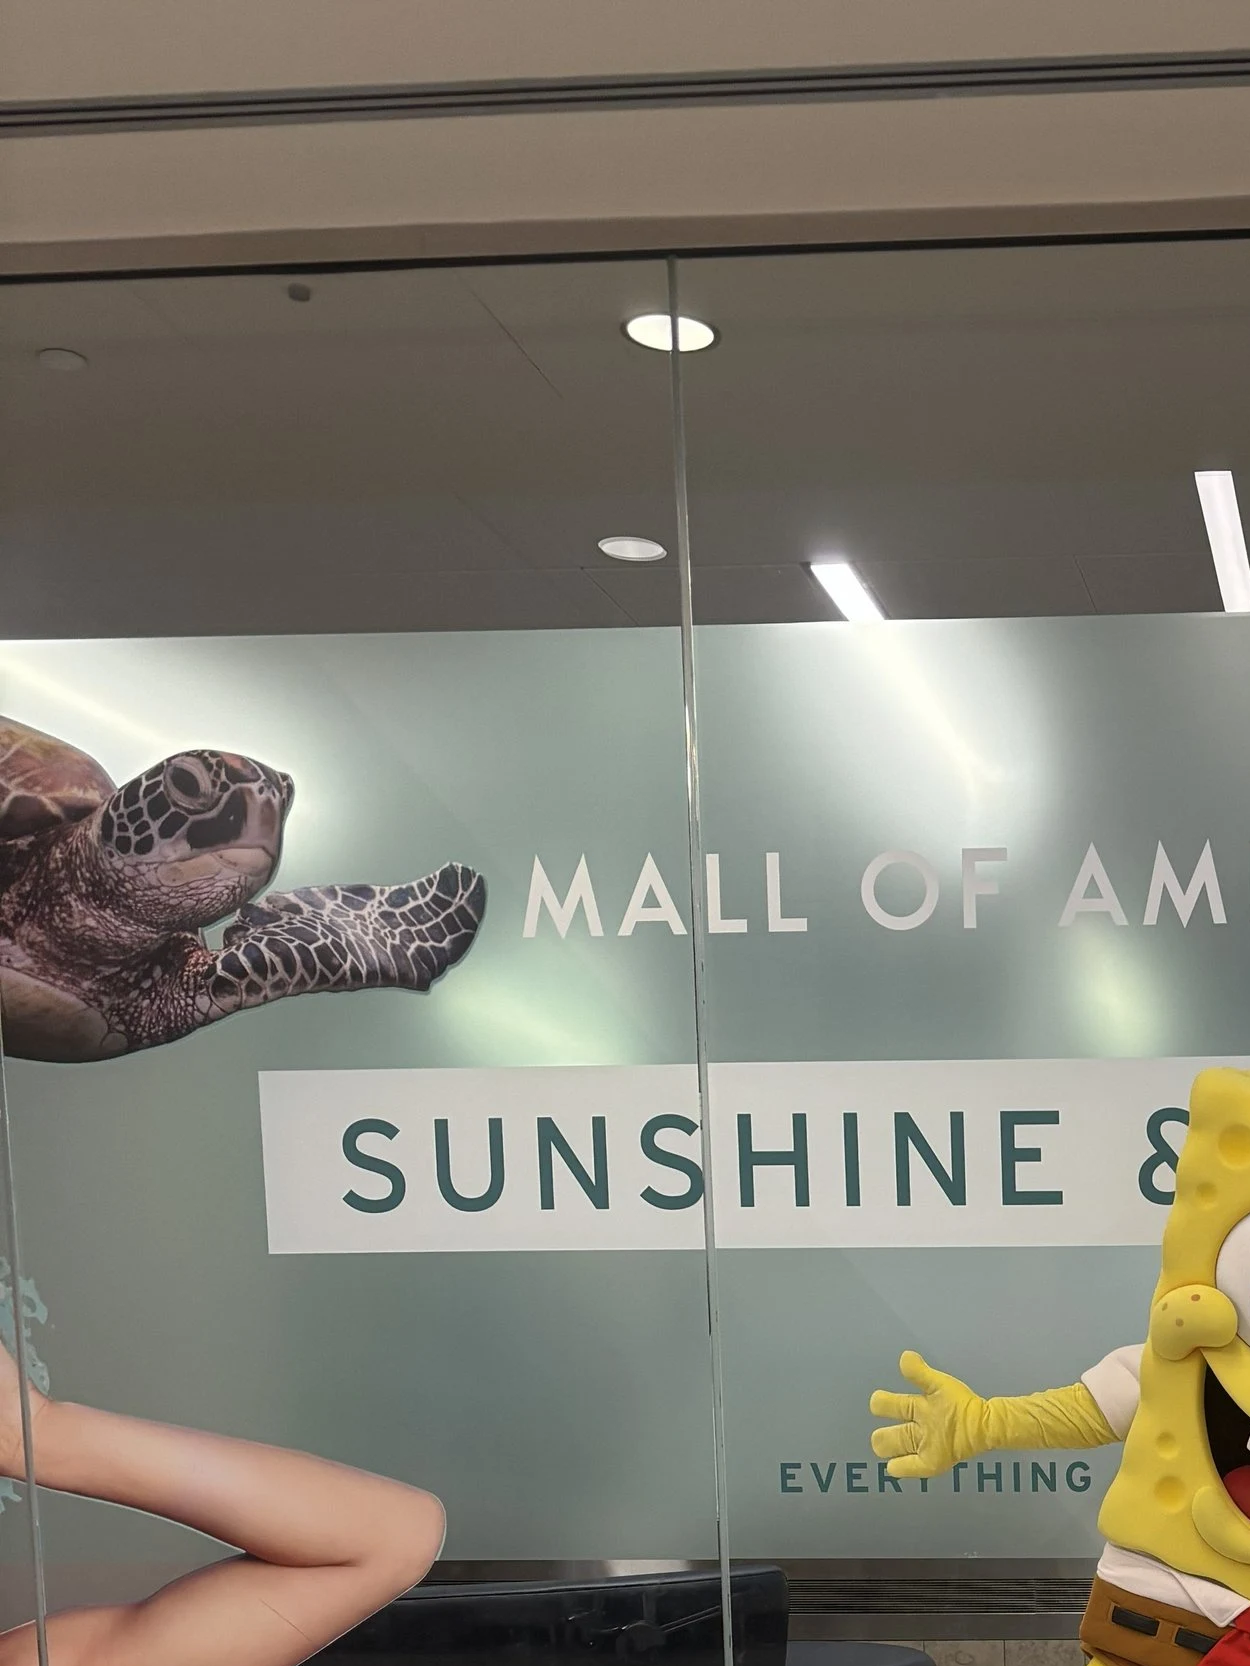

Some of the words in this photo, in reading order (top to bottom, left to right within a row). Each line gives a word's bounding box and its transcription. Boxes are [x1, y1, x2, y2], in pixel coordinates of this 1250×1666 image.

[522, 851, 808, 940] MALL
[861, 846, 1008, 931] OF
[341, 1109, 1064, 1214] SUNSHINE
